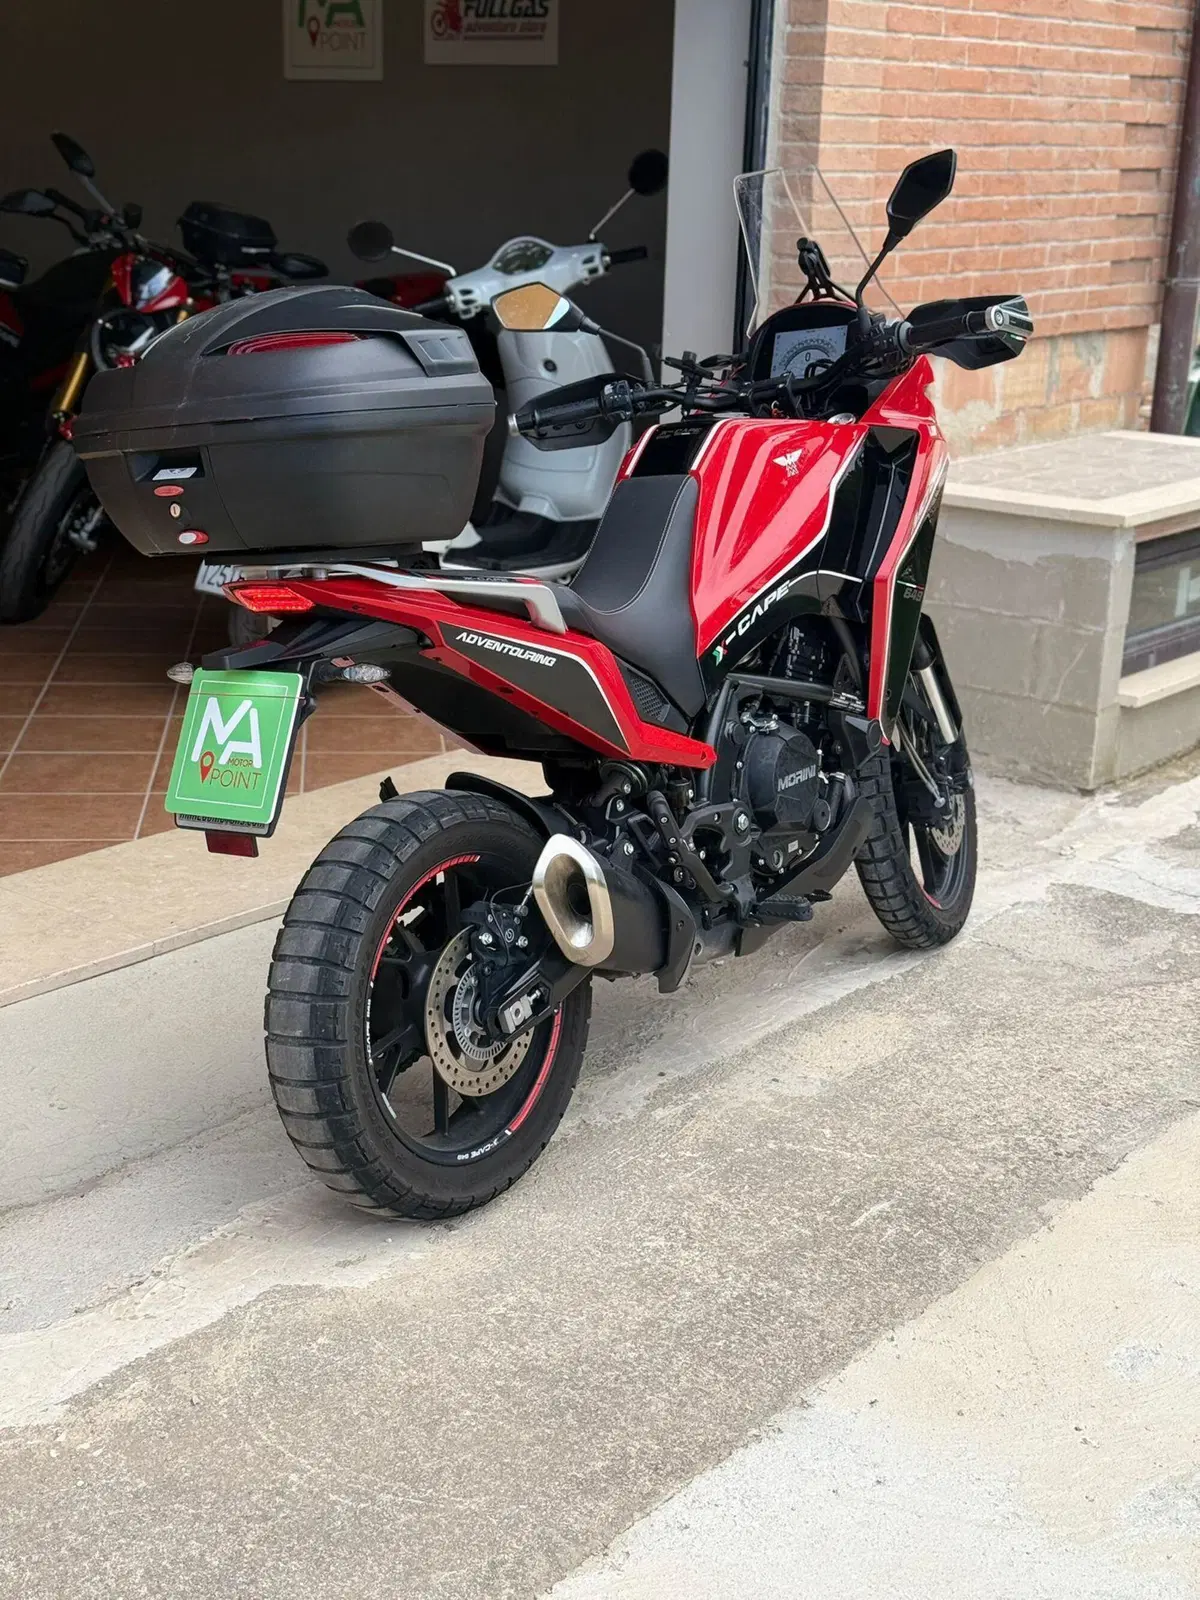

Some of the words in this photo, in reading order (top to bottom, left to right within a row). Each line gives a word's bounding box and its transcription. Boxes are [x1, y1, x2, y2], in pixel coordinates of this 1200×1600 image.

[320, 31, 368, 51] PONT
[712, 579, 791, 667] X-CAPE
[455, 631, 557, 667] ADVENTOURING
[191, 696, 262, 769] MA
[228, 757, 253, 768] MOTOR
[209, 768, 262, 790] POINT
[777, 764, 816, 792] MORINI
